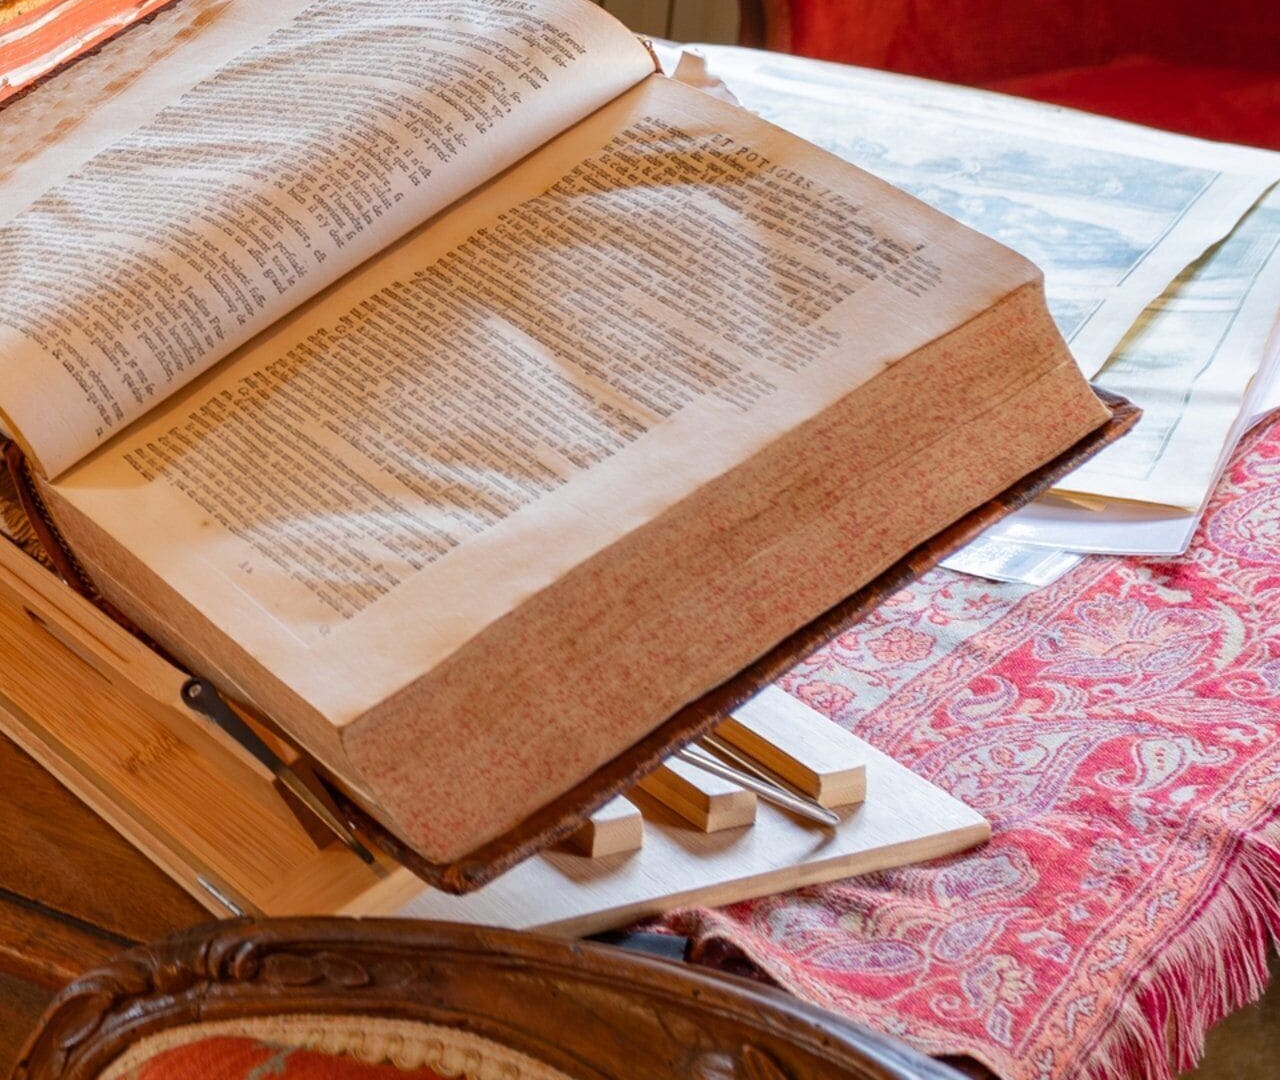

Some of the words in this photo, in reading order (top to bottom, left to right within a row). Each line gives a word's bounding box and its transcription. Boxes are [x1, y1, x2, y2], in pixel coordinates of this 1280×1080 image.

[518, 72, 541, 90] pour
[436, 90, 474, 121] beaucoup
[336, 168, 351, 180] des
[355, 156, 391, 192] plaindre,
[393, 156, 409, 172] que
[408, 172, 420, 186] les
[312, 194, 346, 228] convient
[361, 210, 373, 224] les
[263, 268, 287, 294] grand
[114, 341, 130, 358] que
